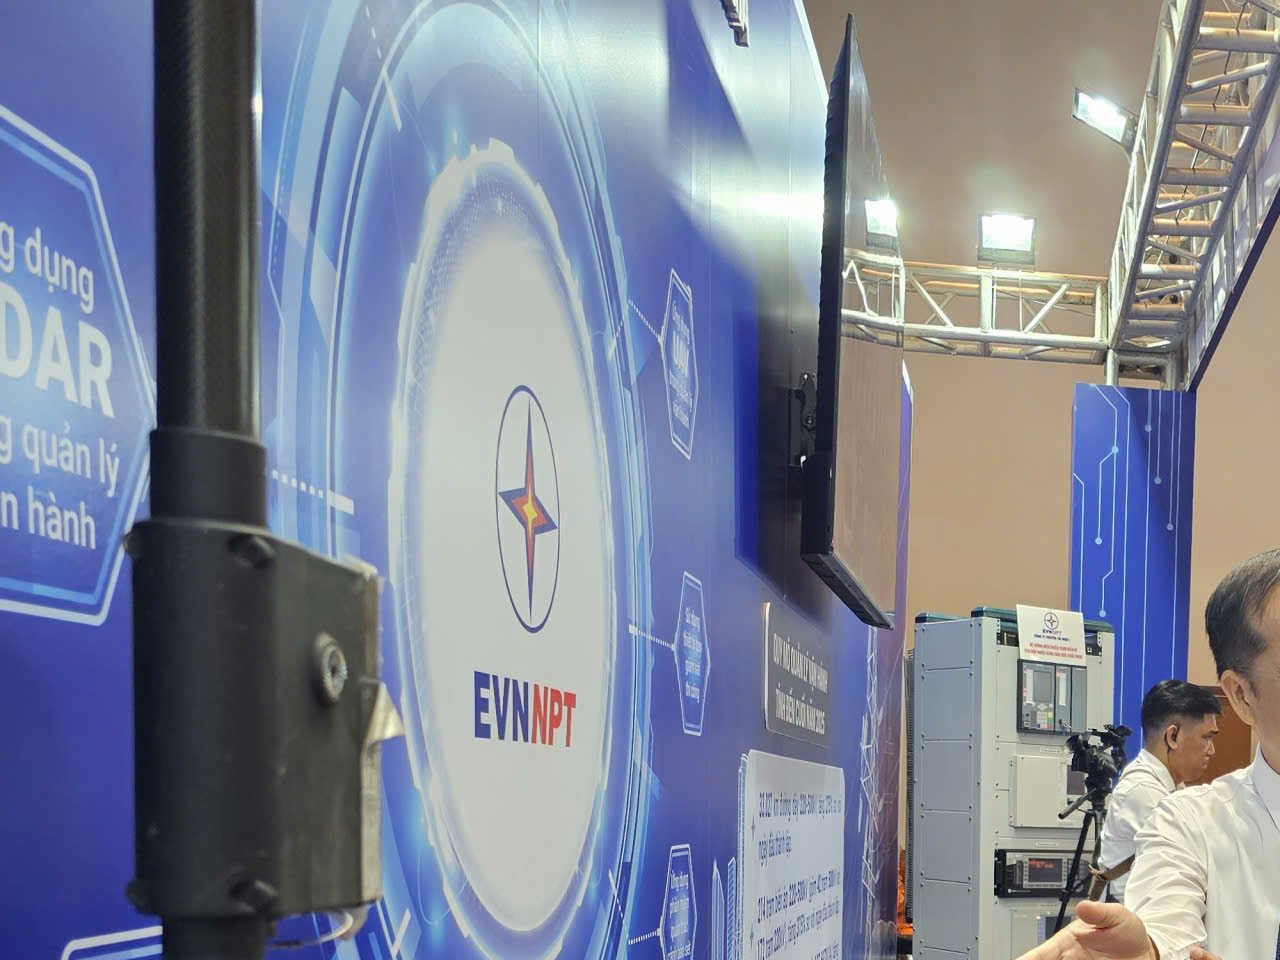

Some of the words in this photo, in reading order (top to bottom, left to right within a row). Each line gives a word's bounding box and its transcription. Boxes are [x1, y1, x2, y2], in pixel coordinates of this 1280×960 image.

[25, 227, 95, 314] dụng
[673, 331, 689, 376] UAV
[22, 420, 91, 480] quản
[98, 432, 121, 499] lý
[28, 486, 97, 551] hành
[773, 632, 783, 666] QUY
[473, 670, 576, 748] EVNNPT
[757, 896, 765, 923] 214
